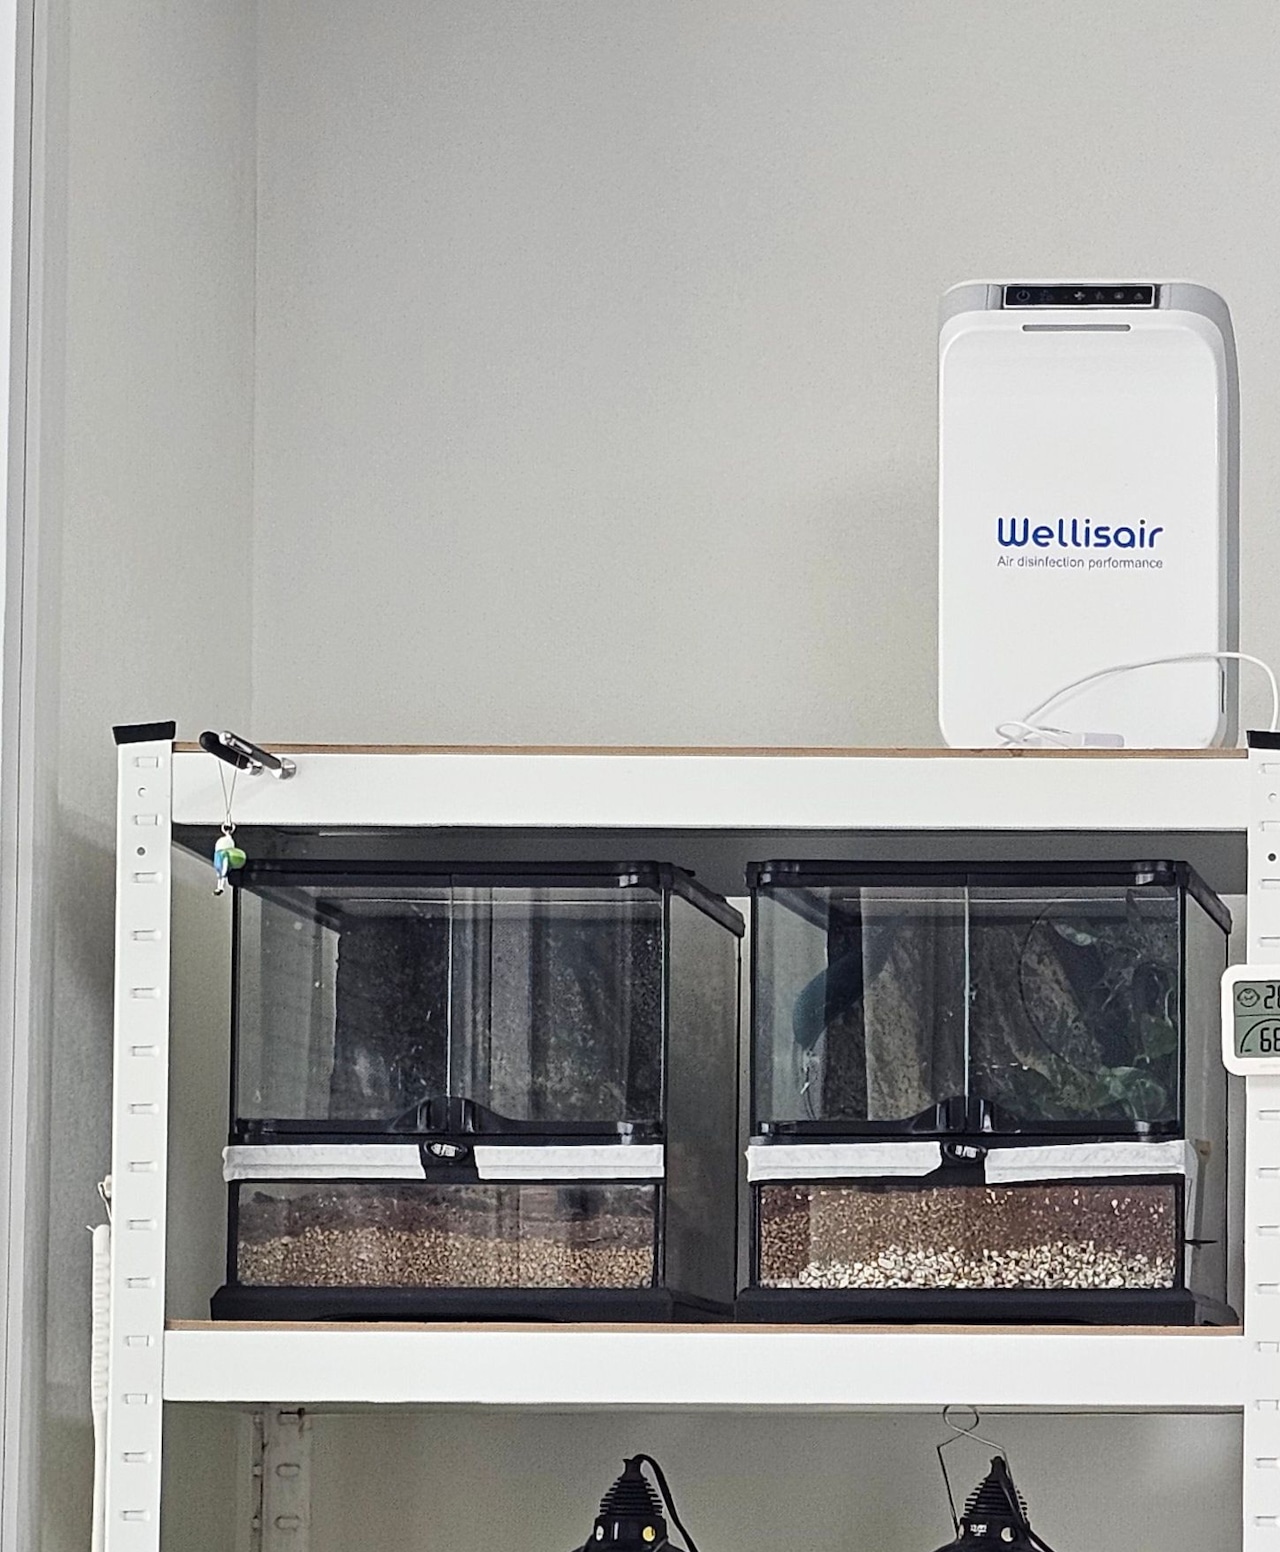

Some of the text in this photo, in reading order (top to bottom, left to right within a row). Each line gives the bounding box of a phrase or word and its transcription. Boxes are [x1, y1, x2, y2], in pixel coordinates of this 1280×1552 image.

[997, 517, 1164, 548] Wellisair
[997, 556, 1164, 571] Air disinfection performance
